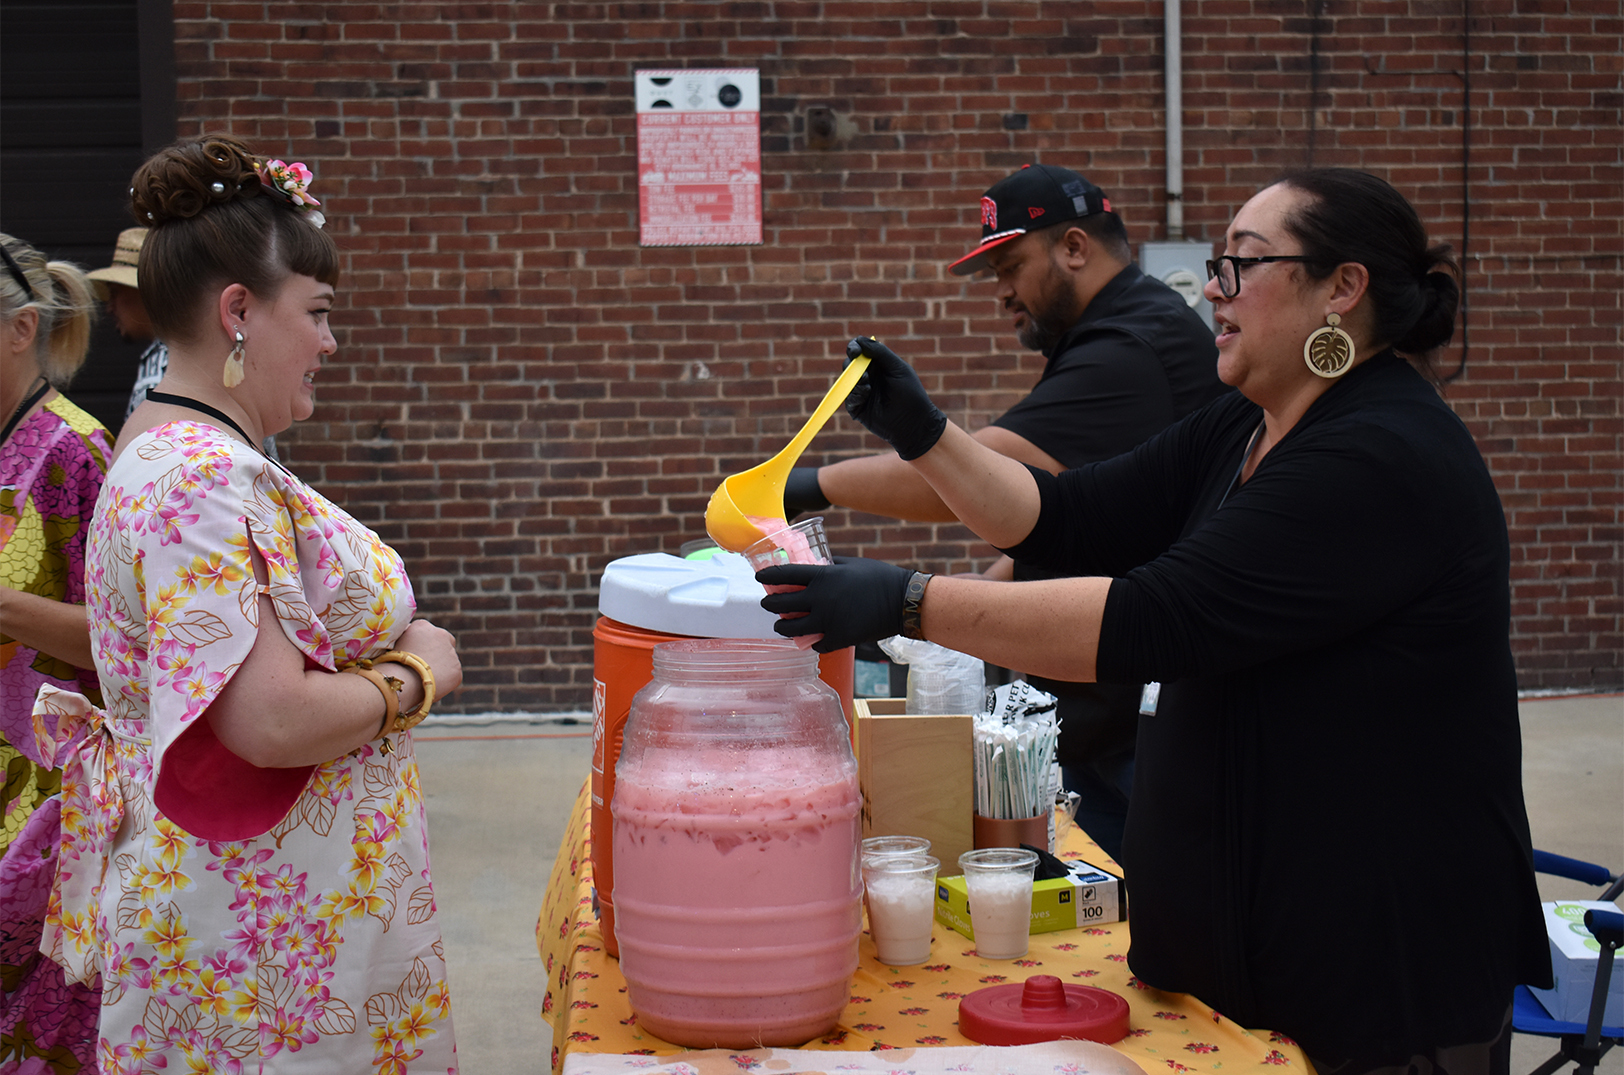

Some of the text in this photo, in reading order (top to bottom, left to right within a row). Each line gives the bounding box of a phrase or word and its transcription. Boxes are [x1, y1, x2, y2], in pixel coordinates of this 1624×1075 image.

[684, 113, 731, 124] CUSTOMER
[1009, 684, 1020, 702] PET
[1061, 893, 1069, 901] M
[1029, 910, 1051, 920] oves
[1082, 905, 1103, 918] 100
[938, 906, 971, 933] Nitrile Gloves
